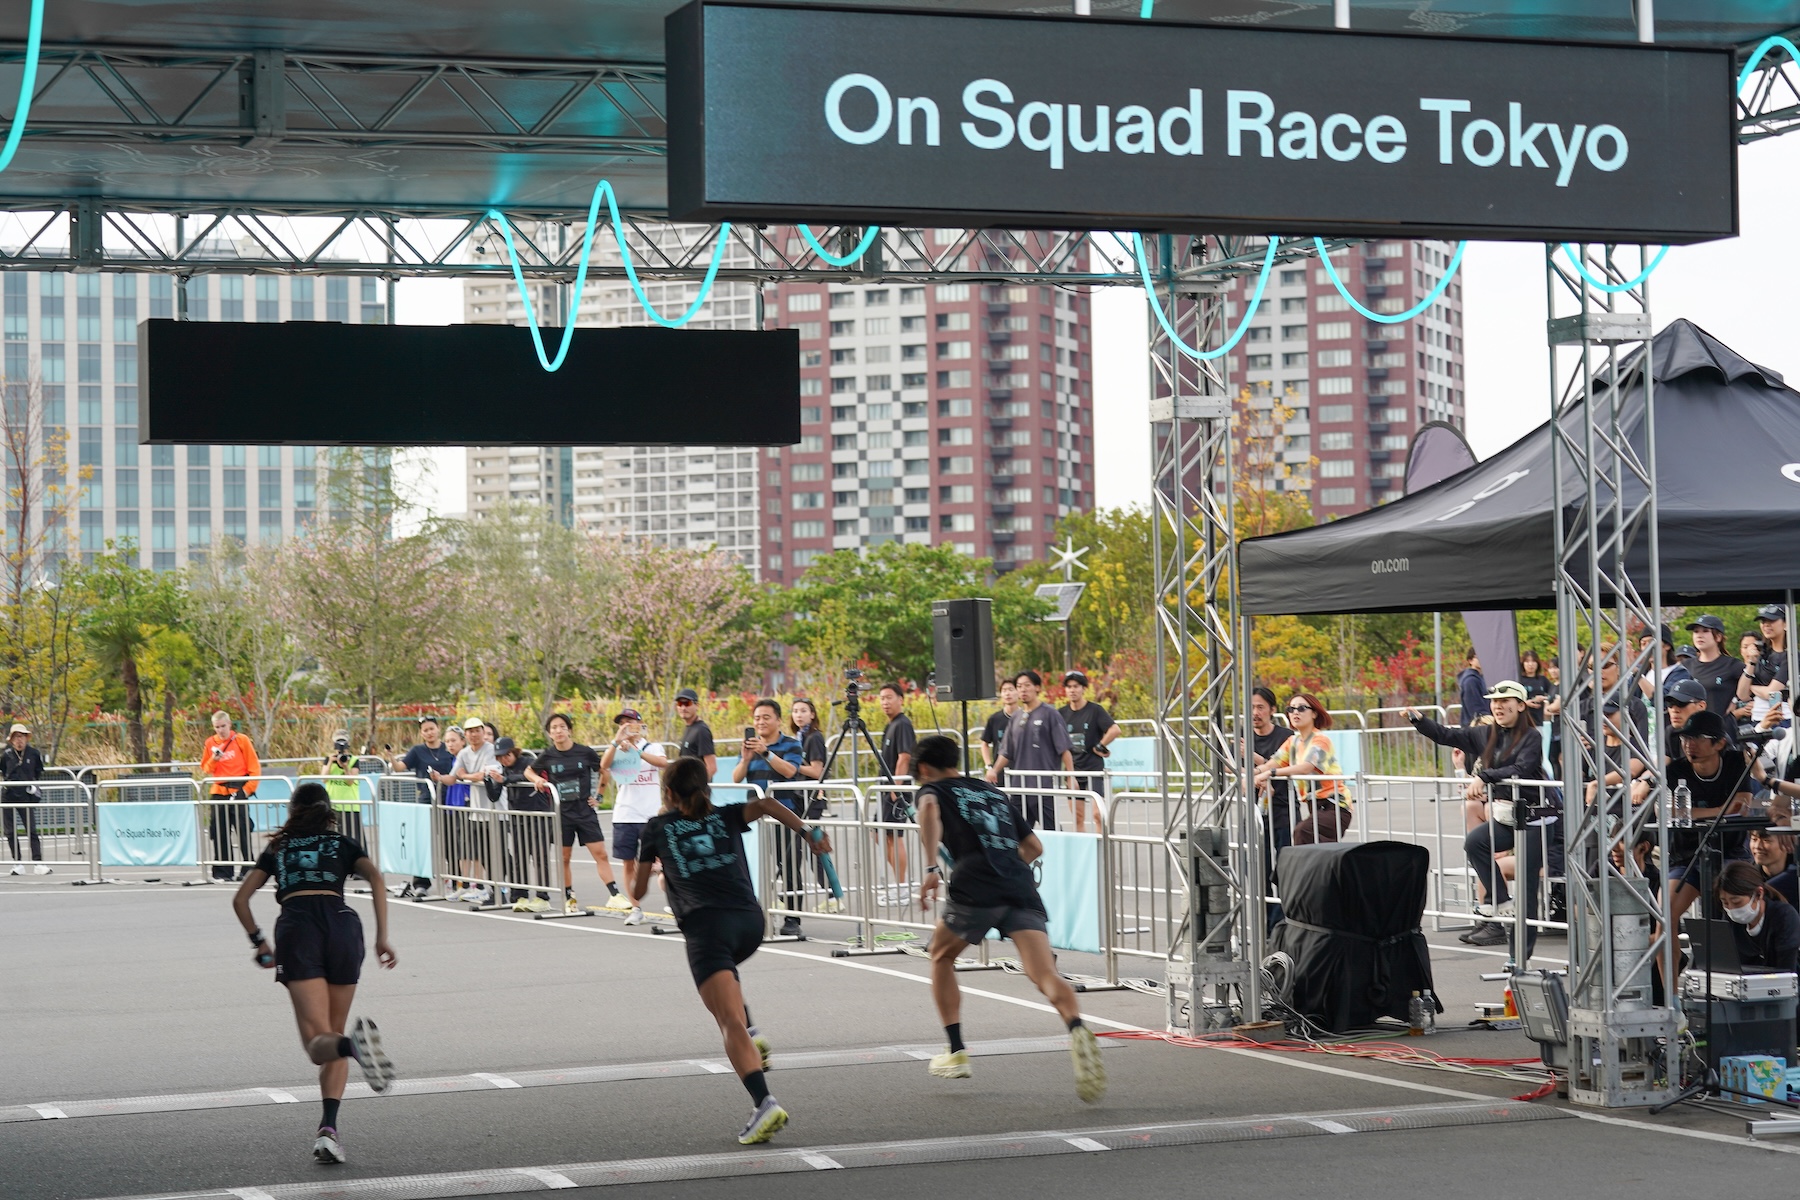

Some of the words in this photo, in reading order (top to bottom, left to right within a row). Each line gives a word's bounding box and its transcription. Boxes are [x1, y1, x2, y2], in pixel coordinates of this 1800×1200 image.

[824, 73, 940, 147] On
[960, 78, 1204, 170] Squad
[1226, 89, 1408, 164] Race
[1419, 97, 1629, 188] Tokyo
[1371, 557, 1410, 575] on.com
[115, 828, 126, 838] On
[126, 828, 146, 840] Squad
[146, 828, 162, 838] Race
[162, 827, 181, 840] Tokyo
